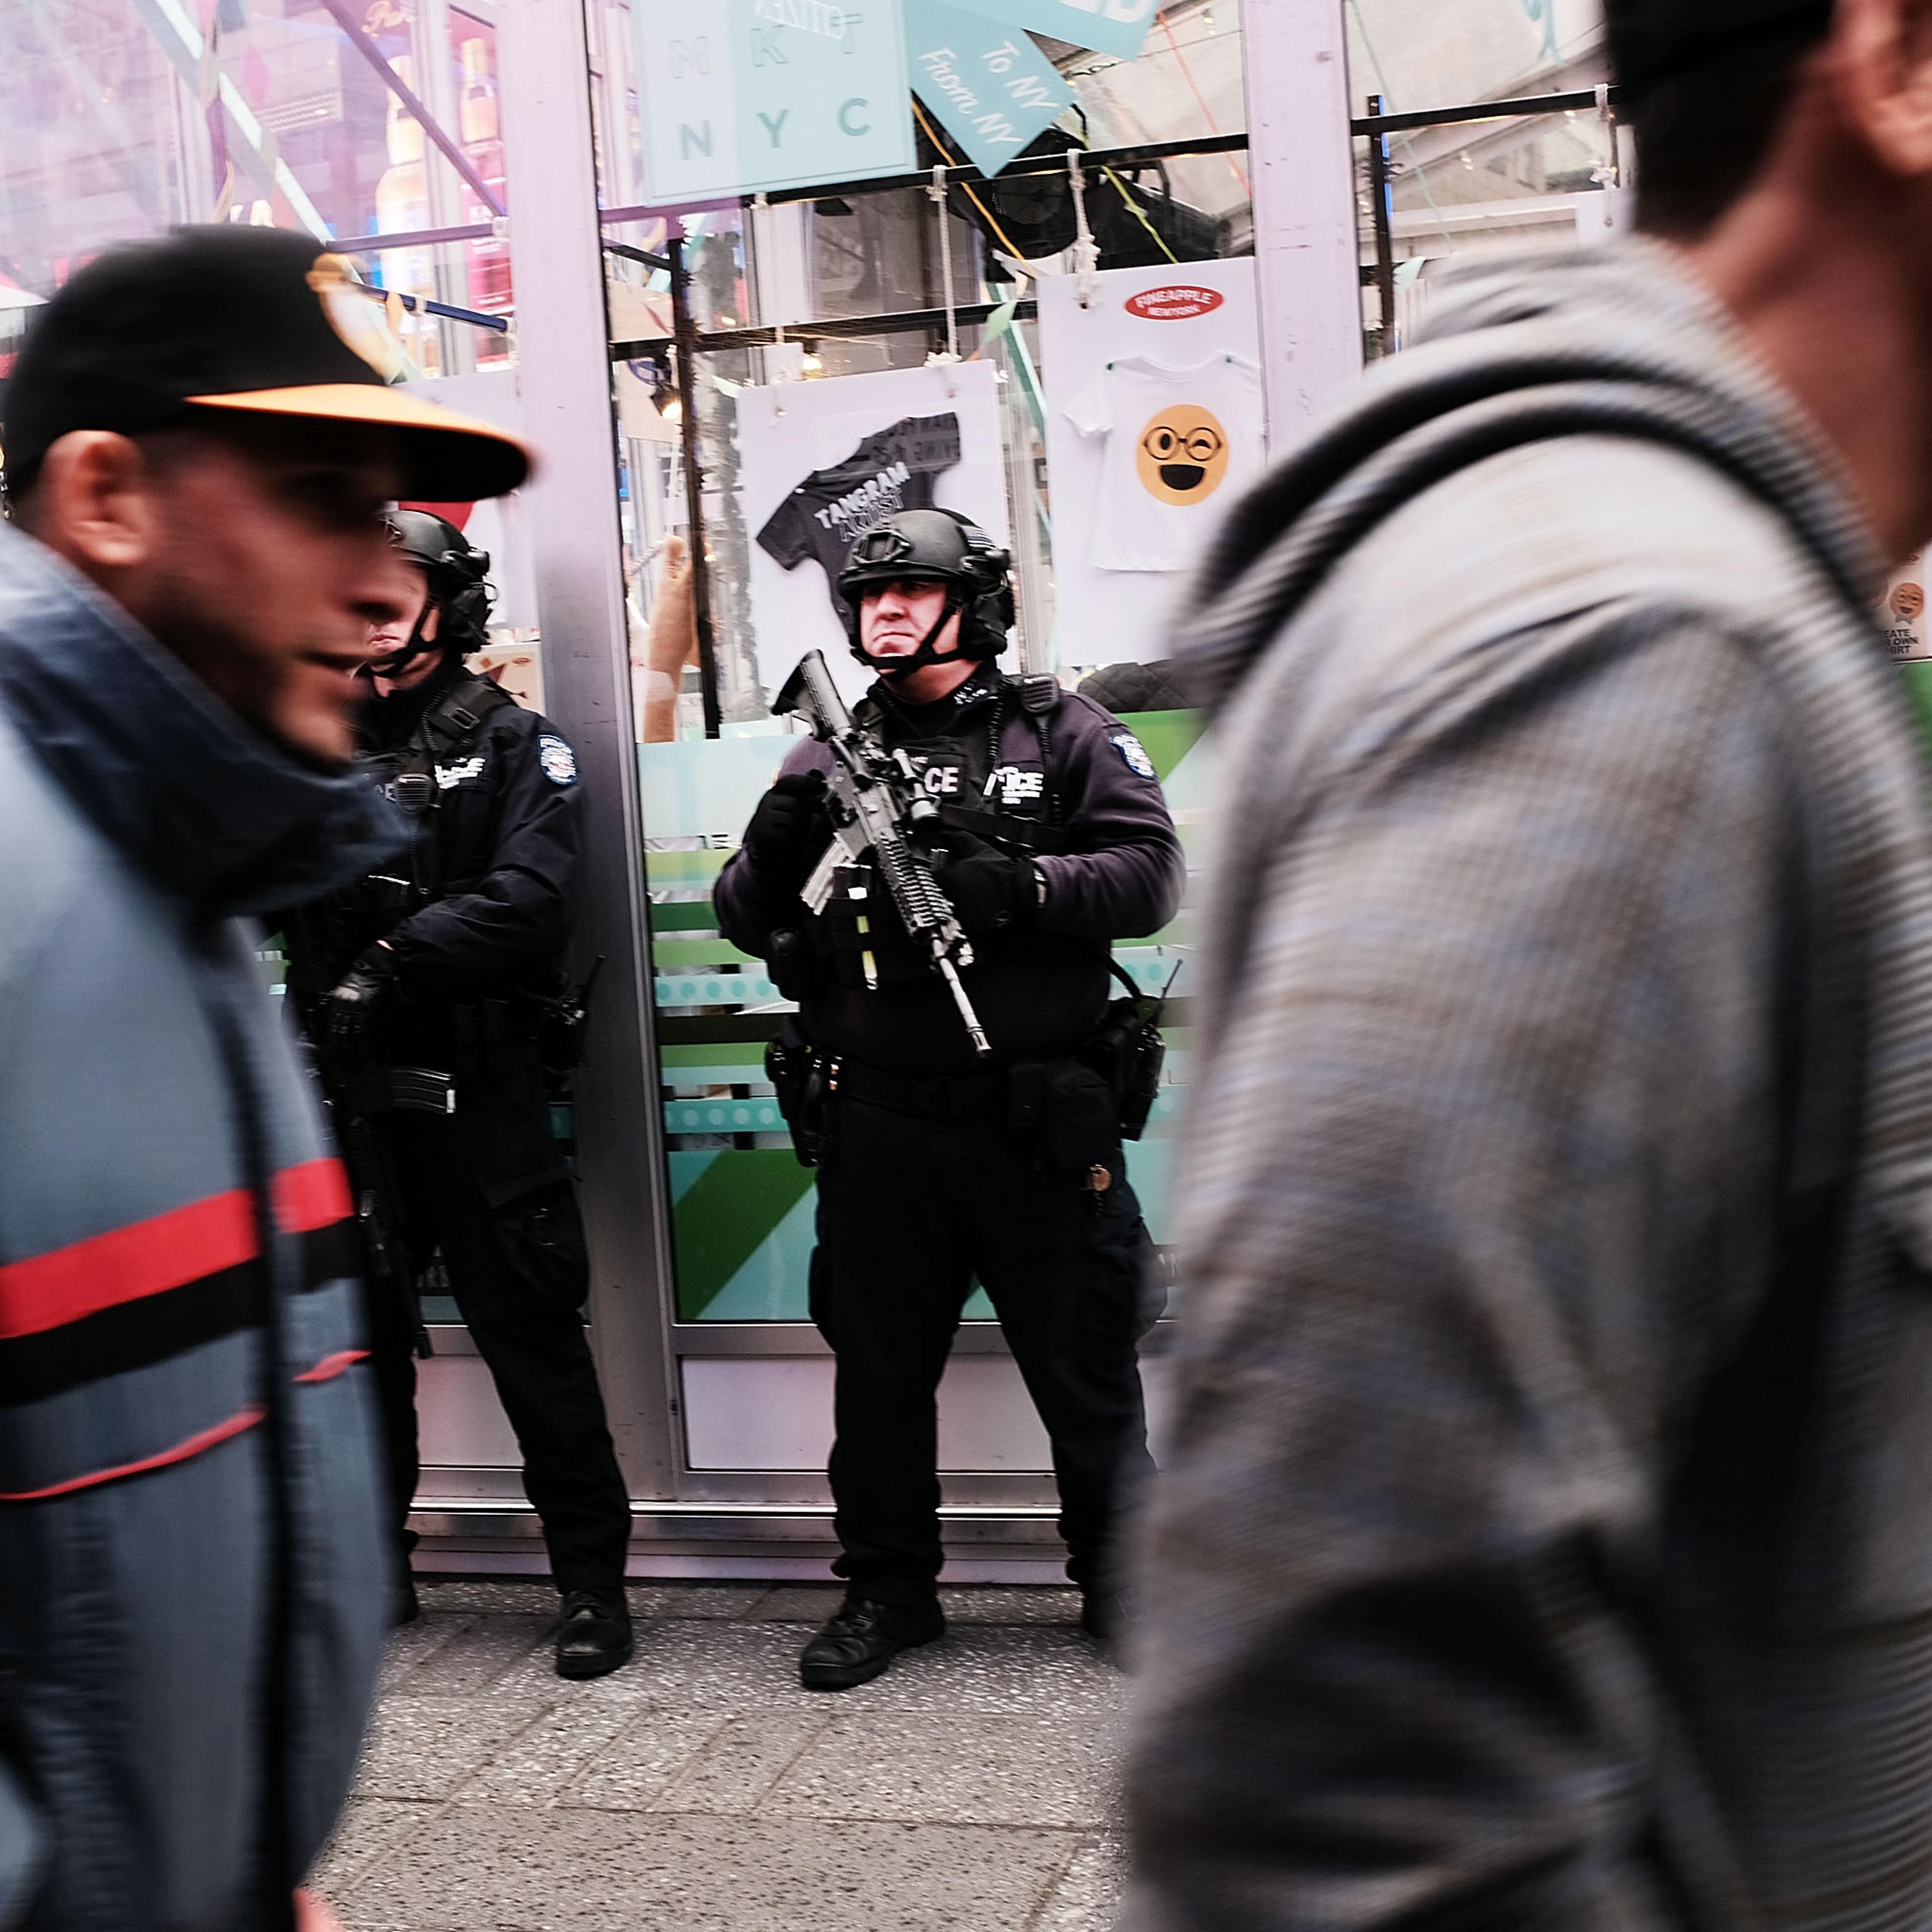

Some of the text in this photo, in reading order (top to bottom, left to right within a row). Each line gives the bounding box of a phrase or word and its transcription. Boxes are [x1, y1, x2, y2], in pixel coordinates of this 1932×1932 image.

[918, 47, 1024, 144] From NY
[981, 39, 1060, 109] To NY
[813, 461, 912, 529] TANGRAM
[1883, 628, 1911, 638] EATE
